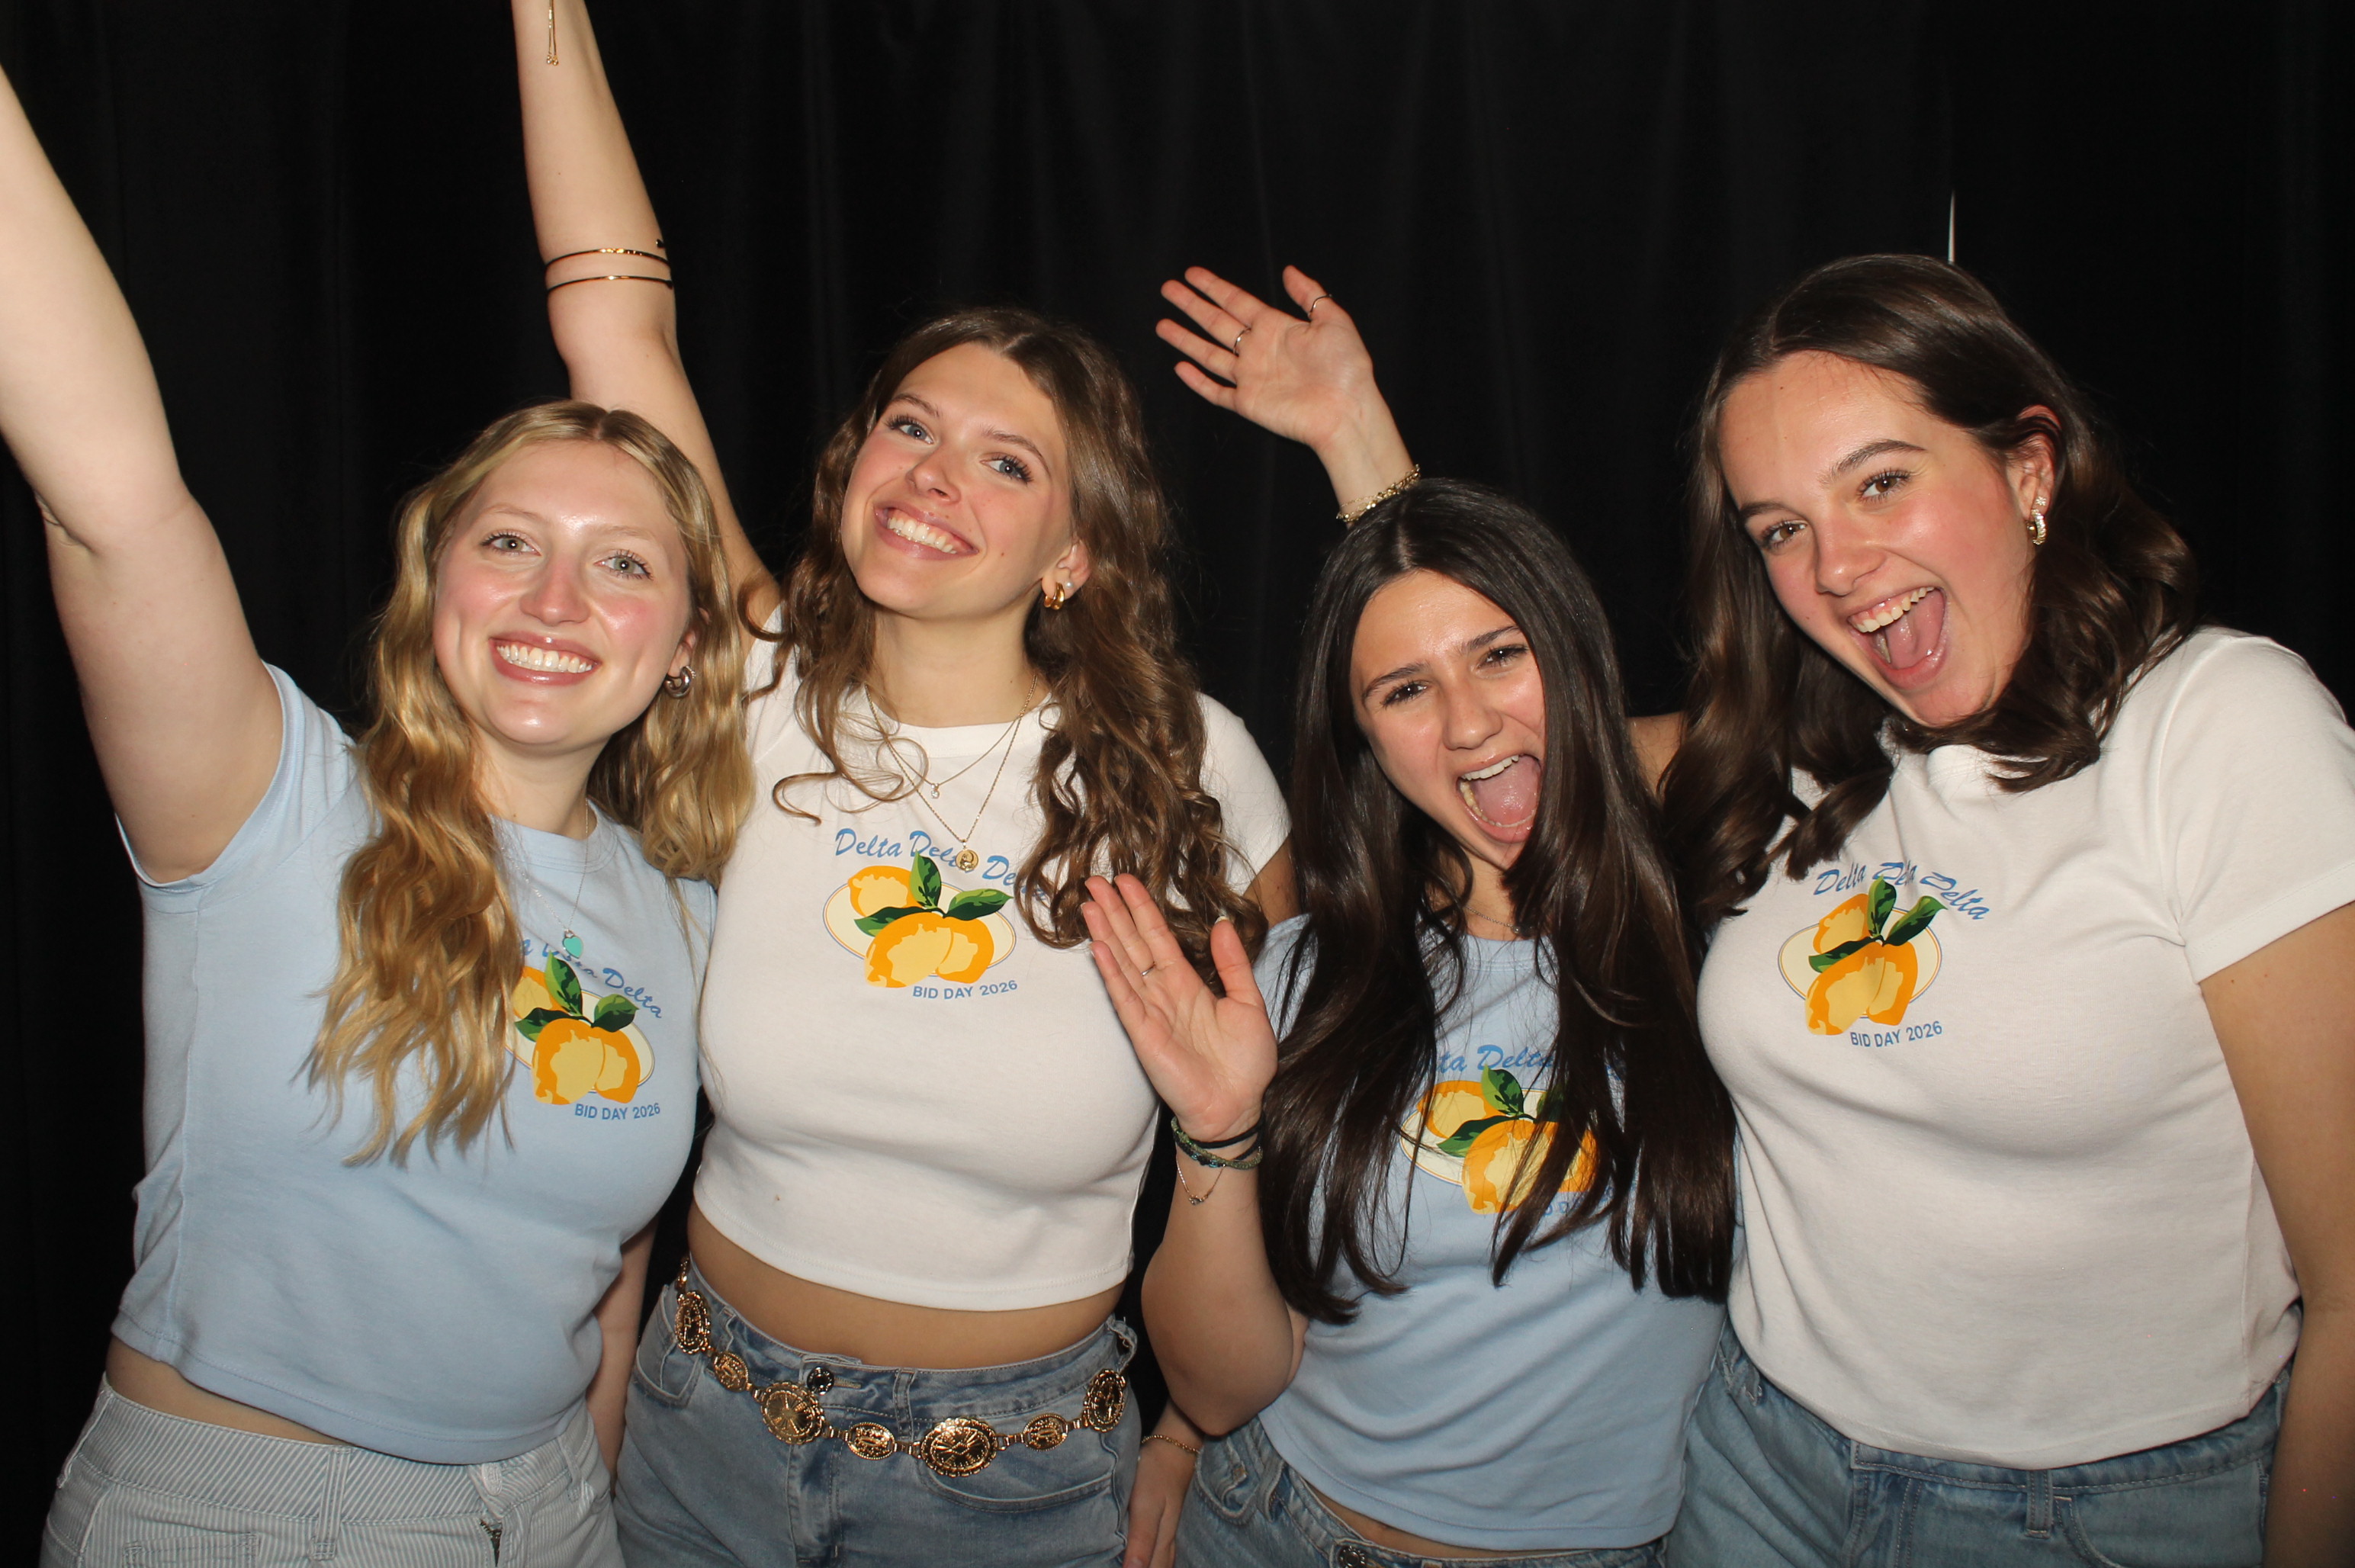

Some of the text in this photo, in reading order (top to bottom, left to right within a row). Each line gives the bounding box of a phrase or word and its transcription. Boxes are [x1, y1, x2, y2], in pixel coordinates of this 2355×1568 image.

[835, 827, 903, 858] Delta
[1813, 862, 1867, 895] Delta
[1920, 872, 1990, 920] Delta
[602, 967, 662, 1019] Delta
[912, 979, 1018, 1000] BID DAY 2026
[1850, 1020, 1942, 1047] BID DAY 2026
[574, 1103, 660, 1120] BID DAY 2026
